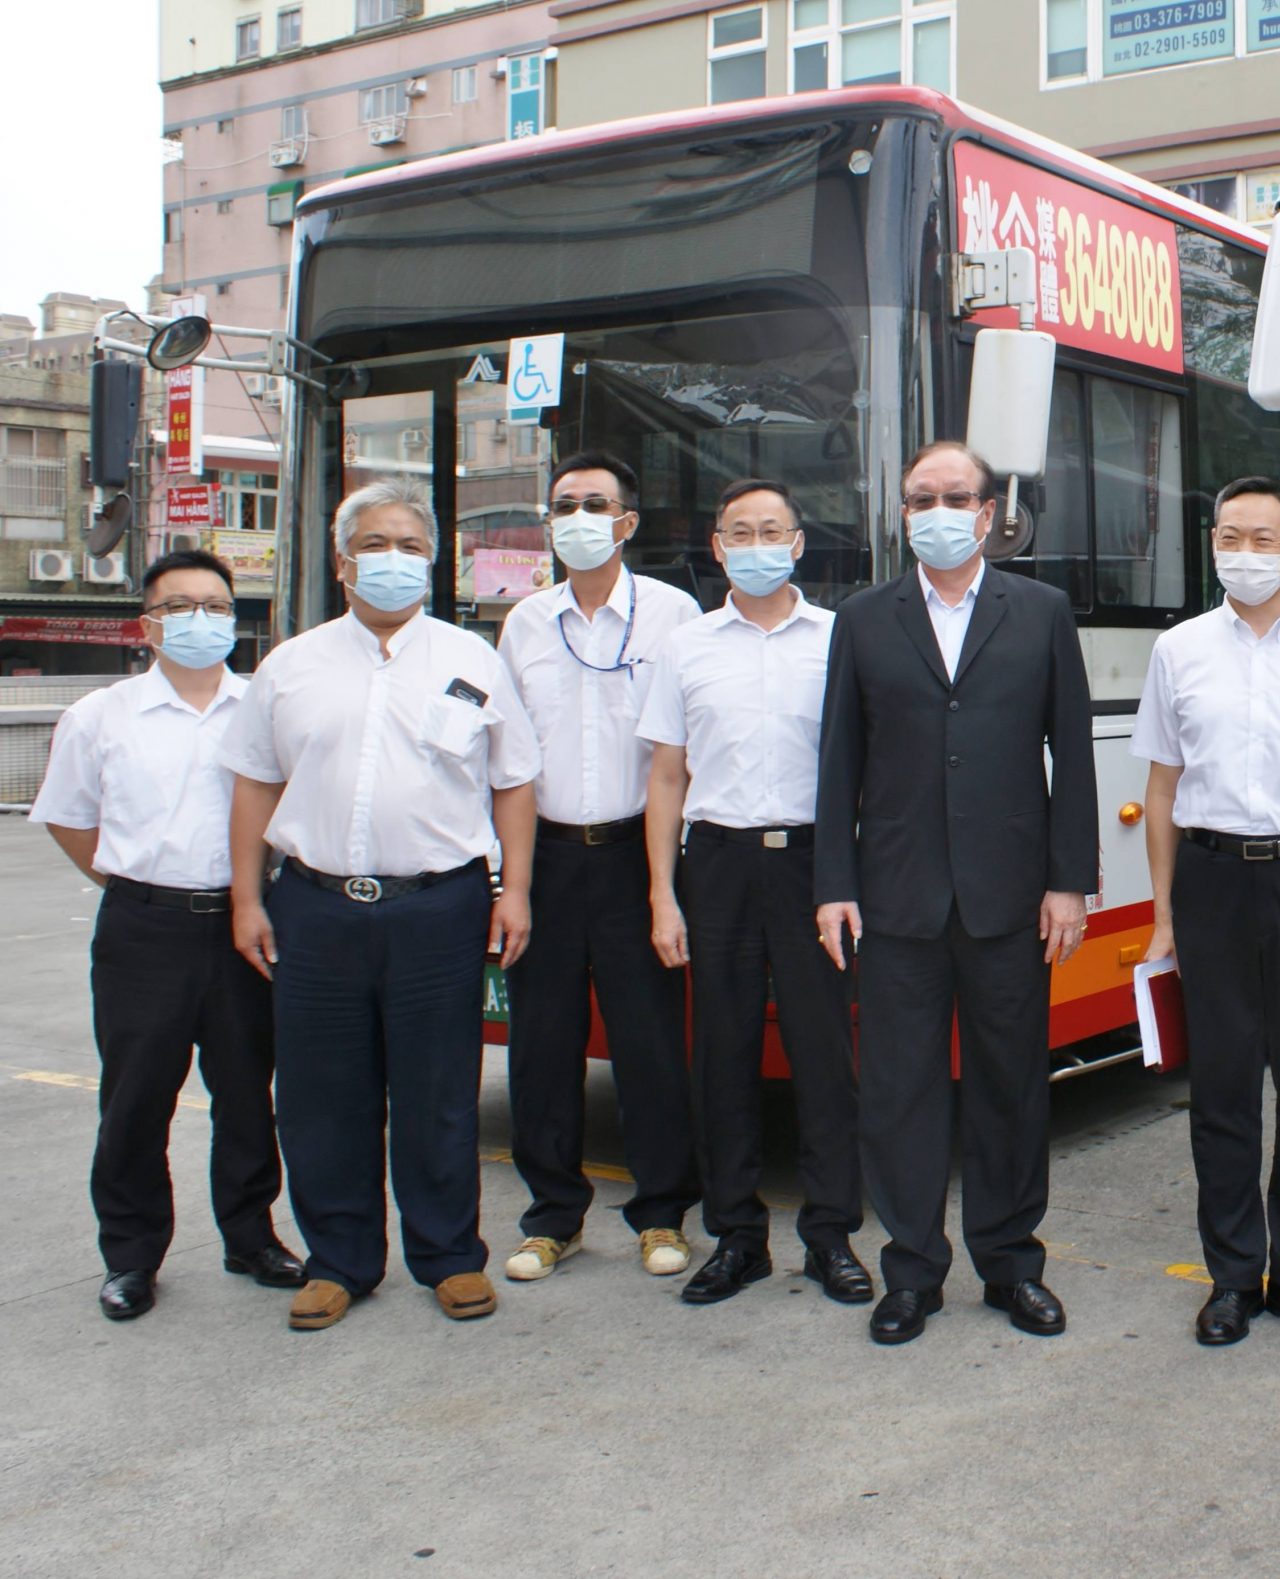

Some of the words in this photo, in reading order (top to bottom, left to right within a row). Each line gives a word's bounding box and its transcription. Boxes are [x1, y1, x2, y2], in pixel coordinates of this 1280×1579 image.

[1134, 0, 1224, 31] 03-376-7909
[1134, 28, 1226, 58] 02-2901-5509
[1057, 206, 1175, 352] 3648088
[46, 620, 79, 630] TOKO
[82, 621, 123, 631] DEPOT
